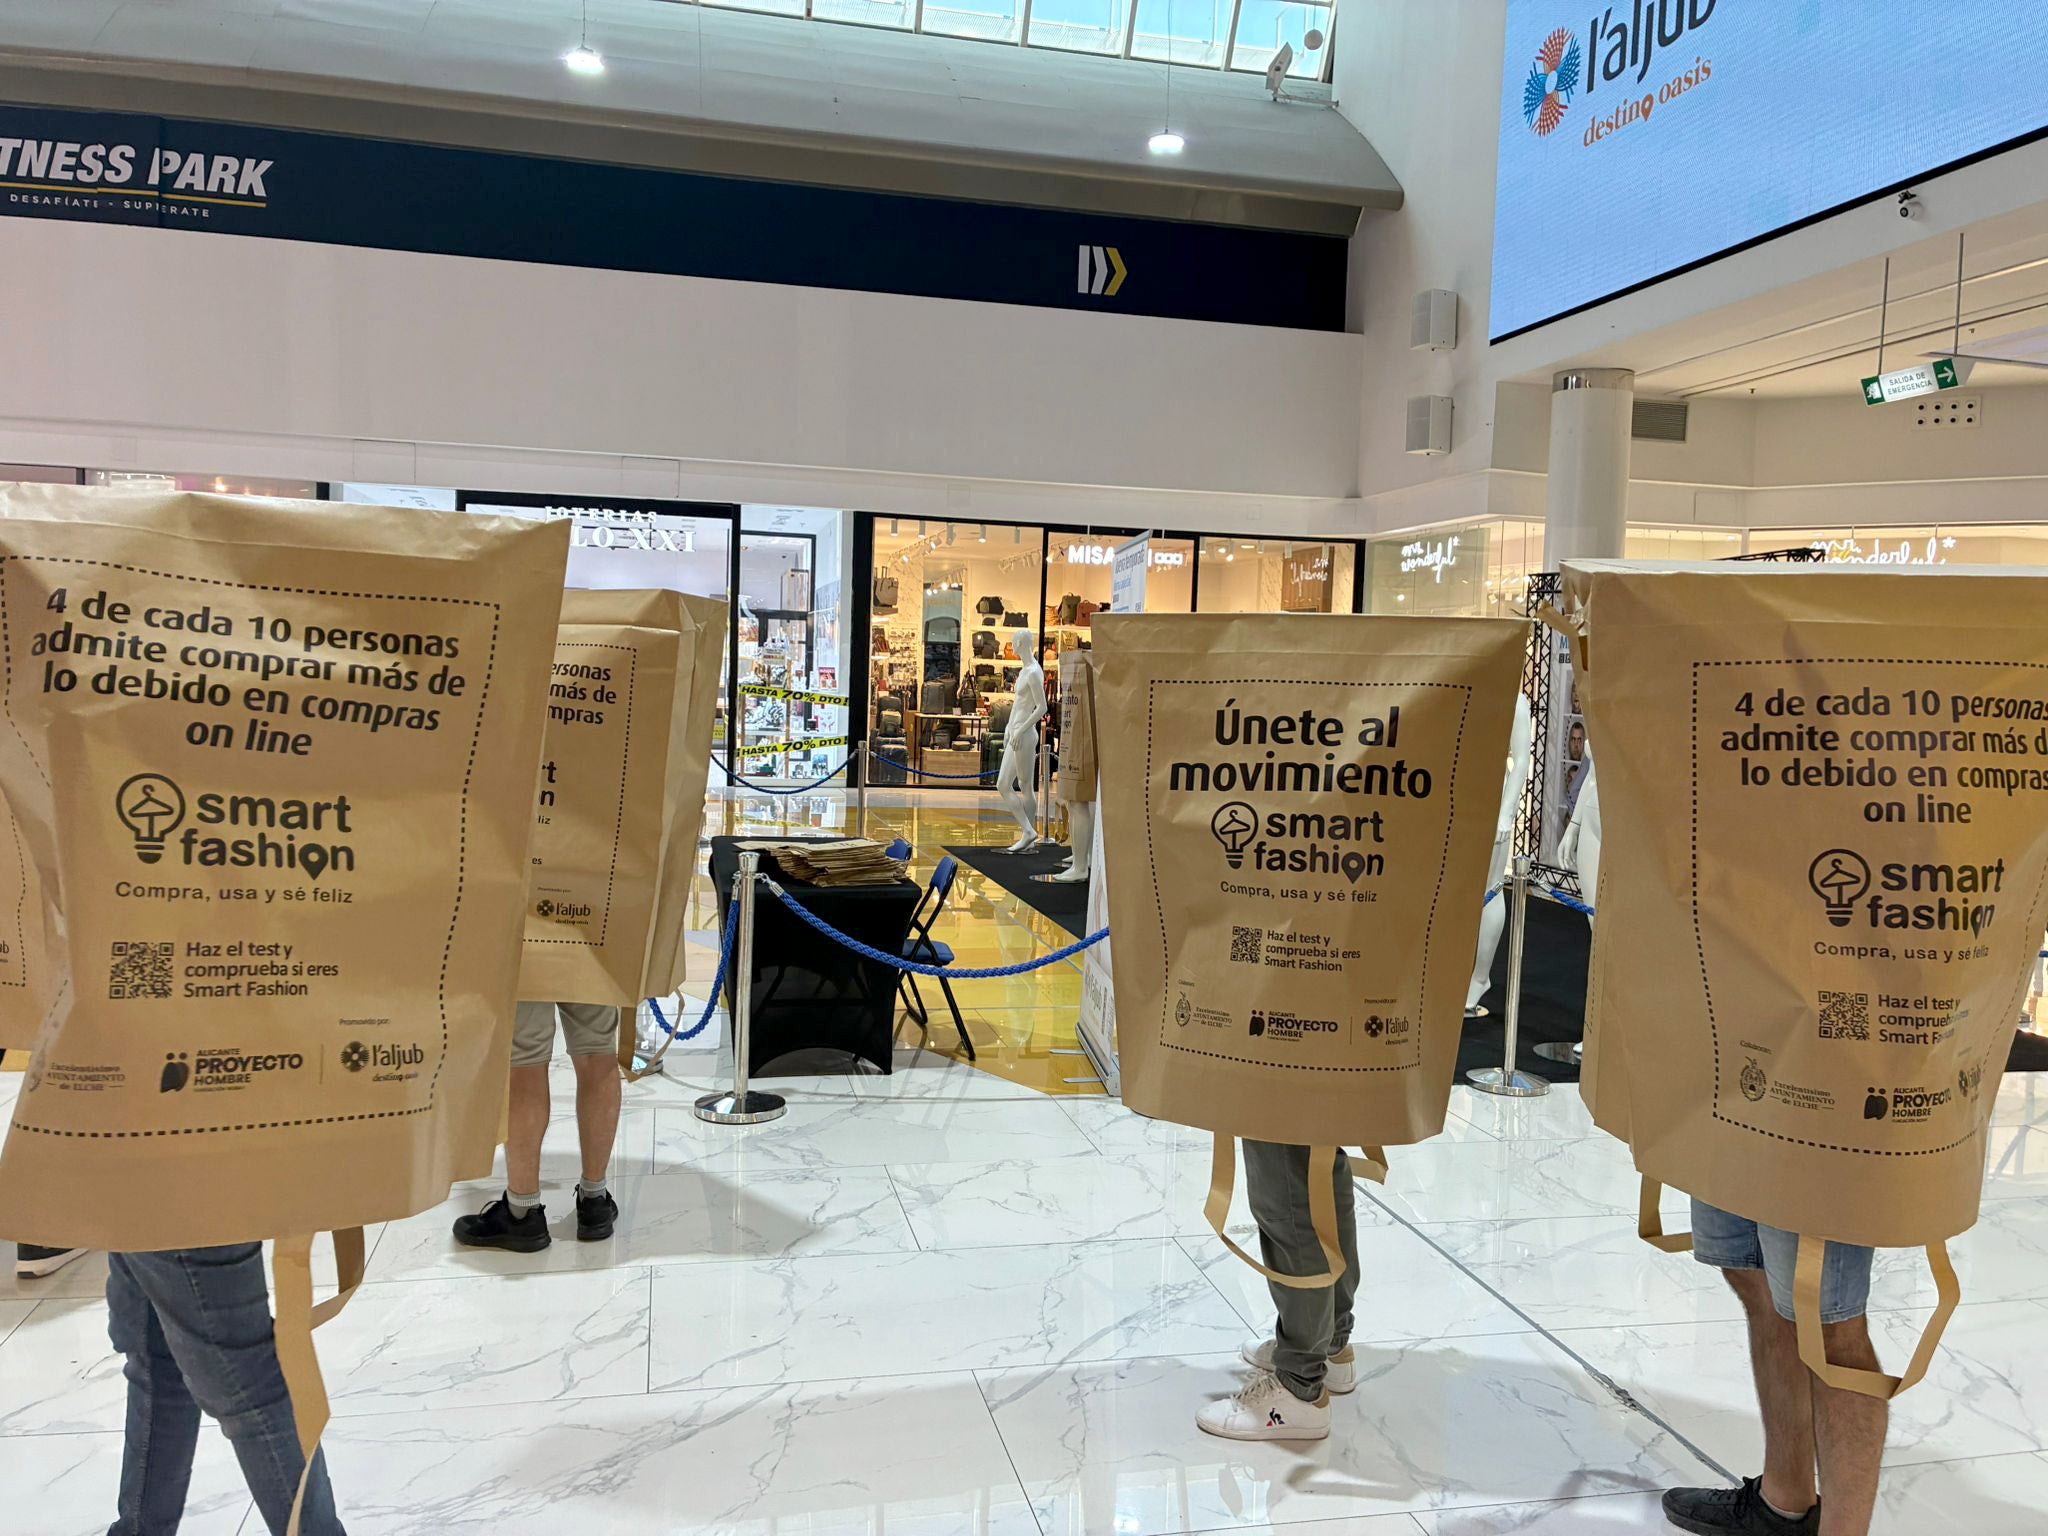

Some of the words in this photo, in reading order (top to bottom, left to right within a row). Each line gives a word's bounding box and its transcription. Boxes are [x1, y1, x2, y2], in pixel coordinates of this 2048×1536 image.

[1583, 93, 1654, 148] destino
[1658, 56, 1712, 105] oasis
[0, 138, 136, 184] TNESS
[147, 147, 274, 197] PARK
[1887, 379, 1933, 395] EMERGENCIA
[1889, 374, 1915, 386] SALIDA
[1915, 371, 1926, 382] DE
[628, 528, 697, 552] XXI
[1067, 544, 1115, 565] MISA
[46, 588, 67, 613] 4
[81, 590, 131, 624] de
[144, 606, 233, 636] cada
[248, 616, 292, 643] 10
[303, 626, 460, 659] personas
[31, 621, 167, 663] admite
[180, 645, 336, 681] comprar
[348, 661, 419, 692] más
[427, 665, 466, 697] de
[551, 662, 612, 682] ersonas
[43, 660, 78, 693] lo
[91, 664, 231, 707] debido
[243, 687, 290, 714] en
[301, 694, 441, 733] compras
[549, 682, 587, 701] más
[593, 685, 617, 704] de
[742, 686, 778, 697] HASTA
[781, 690, 815, 702] 70%
[1734, 692, 1754, 717] 4
[1764, 688, 1805, 717] de
[1816, 687, 1891, 716] cada
[1902, 690, 1941, 716] 10
[547, 704, 604, 725] mpras
[1215, 698, 1344, 747] Únete
[1357, 706, 1400, 748] al
[186, 721, 234, 748] on
[245, 719, 312, 756] line
[781, 739, 815, 752] 70%
[1720, 723, 1840, 752] admite
[1850, 729, 1975, 759] comprar
[1982, 727, 2028, 755] más
[2034, 727, 2048, 755] d
[1169, 751, 1432, 799] movimiento
[1741, 758, 1771, 786] lo
[1781, 758, 1898, 788] debido
[1907, 765, 1947, 788] en
[196, 793, 352, 833] smart
[1863, 801, 1906, 823] on
[1917, 793, 1972, 824] line
[1265, 810, 1384, 843] smart
[180, 828, 355, 880] fashion
[1253, 841, 1384, 884] fashion
[1880, 858, 2005, 893] smart
[115, 881, 211, 903] Compra,
[219, 887, 258, 900] usa
[264, 888, 276, 903] y
[283, 886, 306, 901] sé
[313, 887, 353, 904] feliz
[1220, 880, 1275, 900] Compra,
[1280, 887, 1308, 899] usa
[1313, 888, 1323, 903] y
[1327, 889, 1346, 901] sé
[1351, 890, 1377, 903] feliz
[556, 902, 591, 921] l'aljub
[1866, 895, 1996, 940] fashion
[1267, 930, 1284, 942] Haz
[1286, 932, 1297, 943] el
[1299, 933, 1321, 944] test
[1323, 936, 1331, 947] y
[186, 942, 222, 957] Haz
[226, 941, 243, 957] el
[248, 942, 280, 957] test
[283, 944, 293, 960] y
[1265, 944, 1327, 958] comprueba
[1330, 947, 1339, 959] si
[1341, 950, 1361, 959] eres
[1813, 941, 1897, 961] Compra,
[1904, 947, 1938, 960] usa
[1943, 949, 1954, 963] y
[1957, 946, 1971, 960] sé
[184, 961, 289, 980] comprueba
[291, 961, 304, 976] si
[307, 963, 339, 976] eres
[1264, 955, 1296, 969] Smart
[1299, 959, 1343, 972] Fashion
[183, 981, 241, 998] Smart
[246, 981, 309, 997] Fashion
[1878, 994, 1910, 1009] Haz
[1913, 996, 1928, 1010] el
[1932, 997, 1953, 1010] test
[1267, 1016, 1338, 1033] PROYECTO
[1878, 1011, 1955, 1030] comprueb
[1267, 1027, 1304, 1039] HOMBRE
[1879, 1029, 1929, 1045] Smart
[195, 1053, 303, 1074] PROYECTO
[372, 1043, 424, 1071] l'aljub
[194, 1073, 252, 1086] HOMBRE
[1892, 1107, 1932, 1118] HOMBRE
